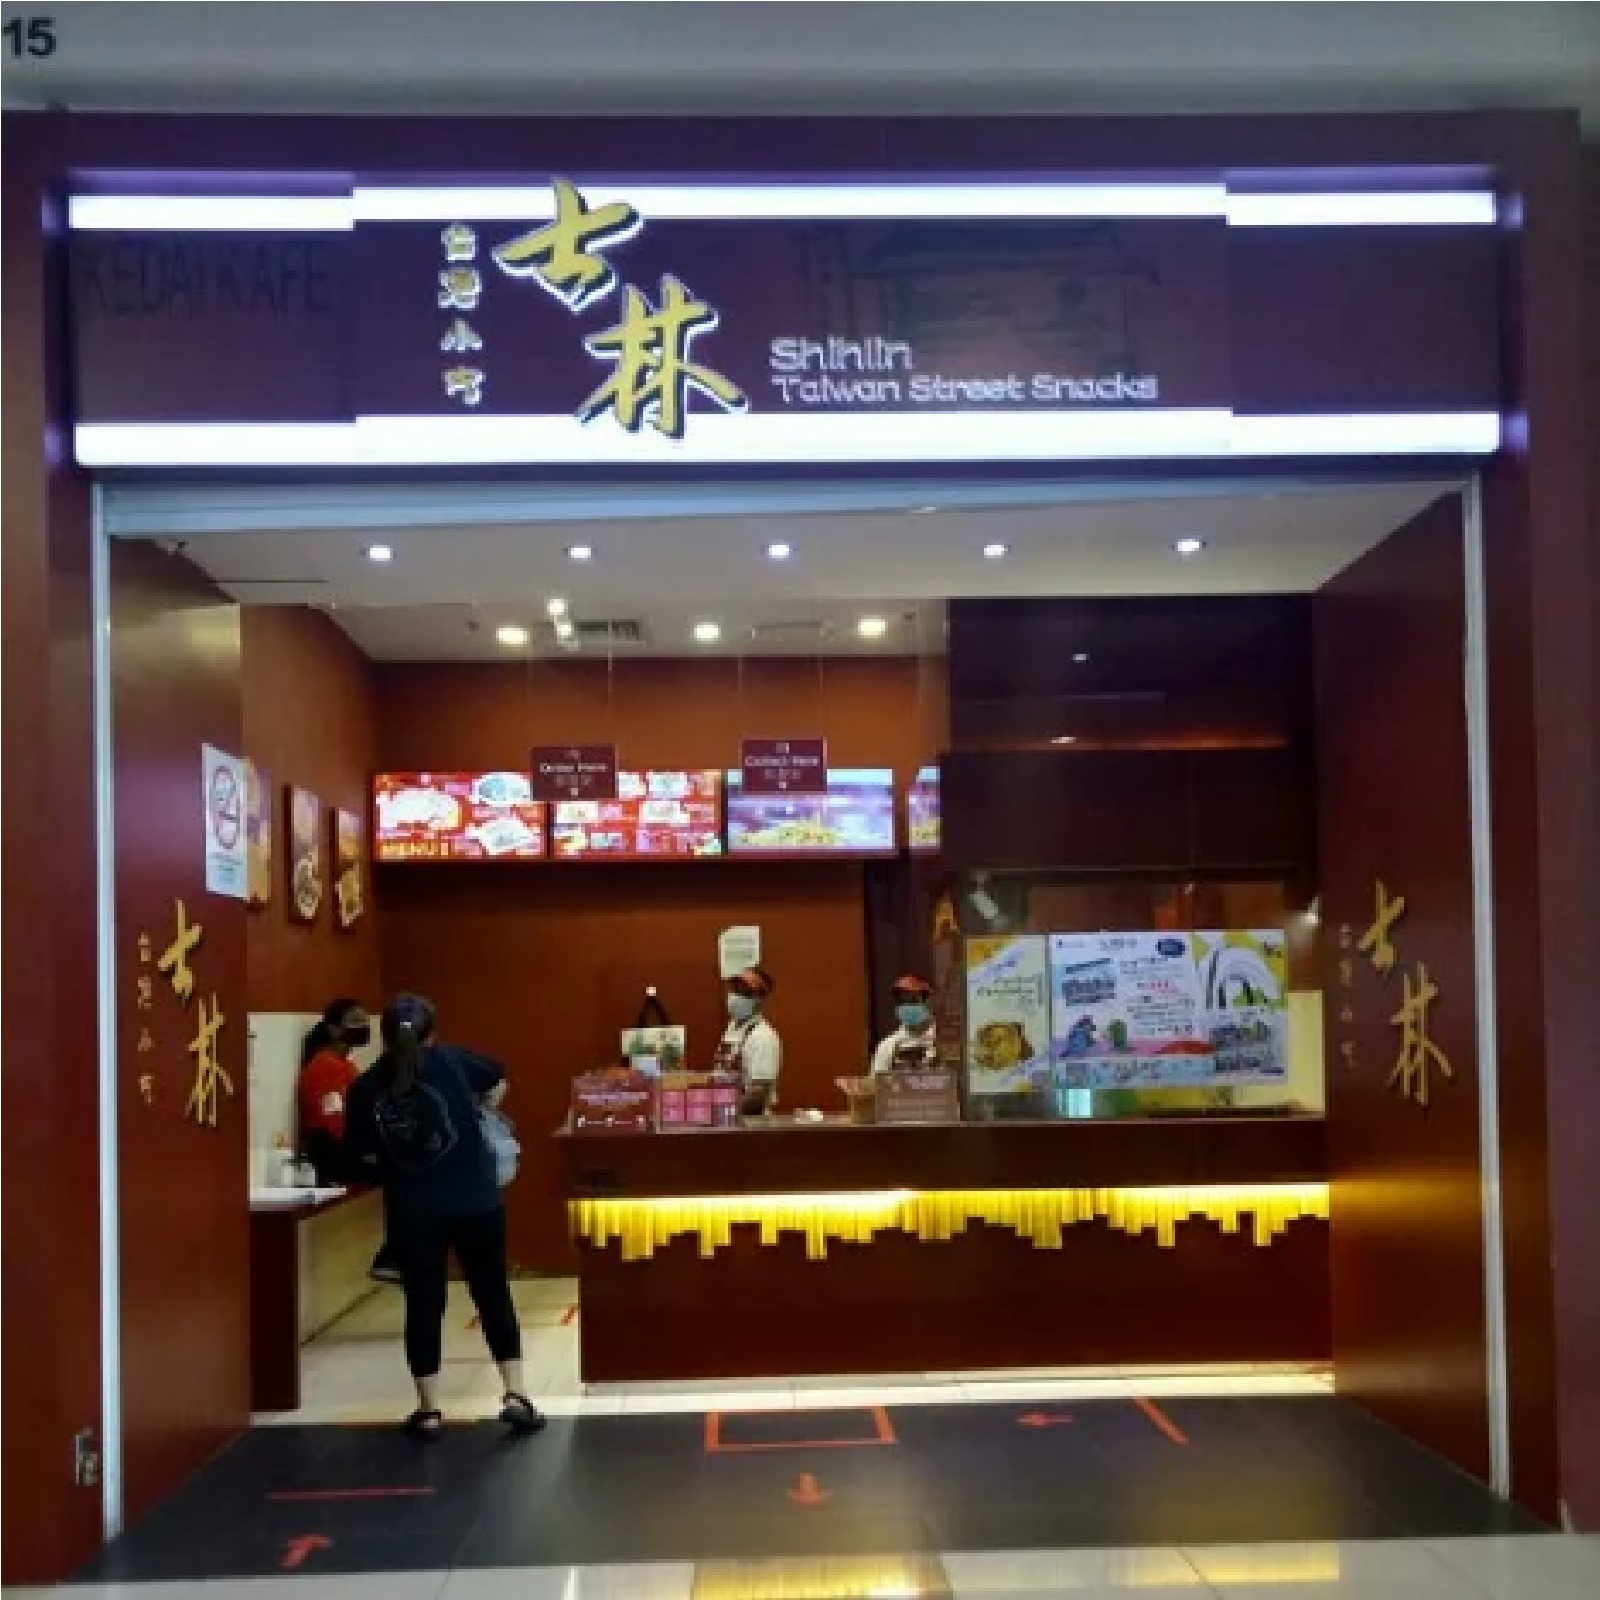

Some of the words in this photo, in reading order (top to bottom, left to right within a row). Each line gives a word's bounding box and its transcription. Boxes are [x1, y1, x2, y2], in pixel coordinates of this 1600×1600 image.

[2, 17, 56, 58] 15
[771, 375, 901, 403] Taiwan
[908, 375, 1027, 401] Street
[1032, 373, 1159, 400] Snacks
